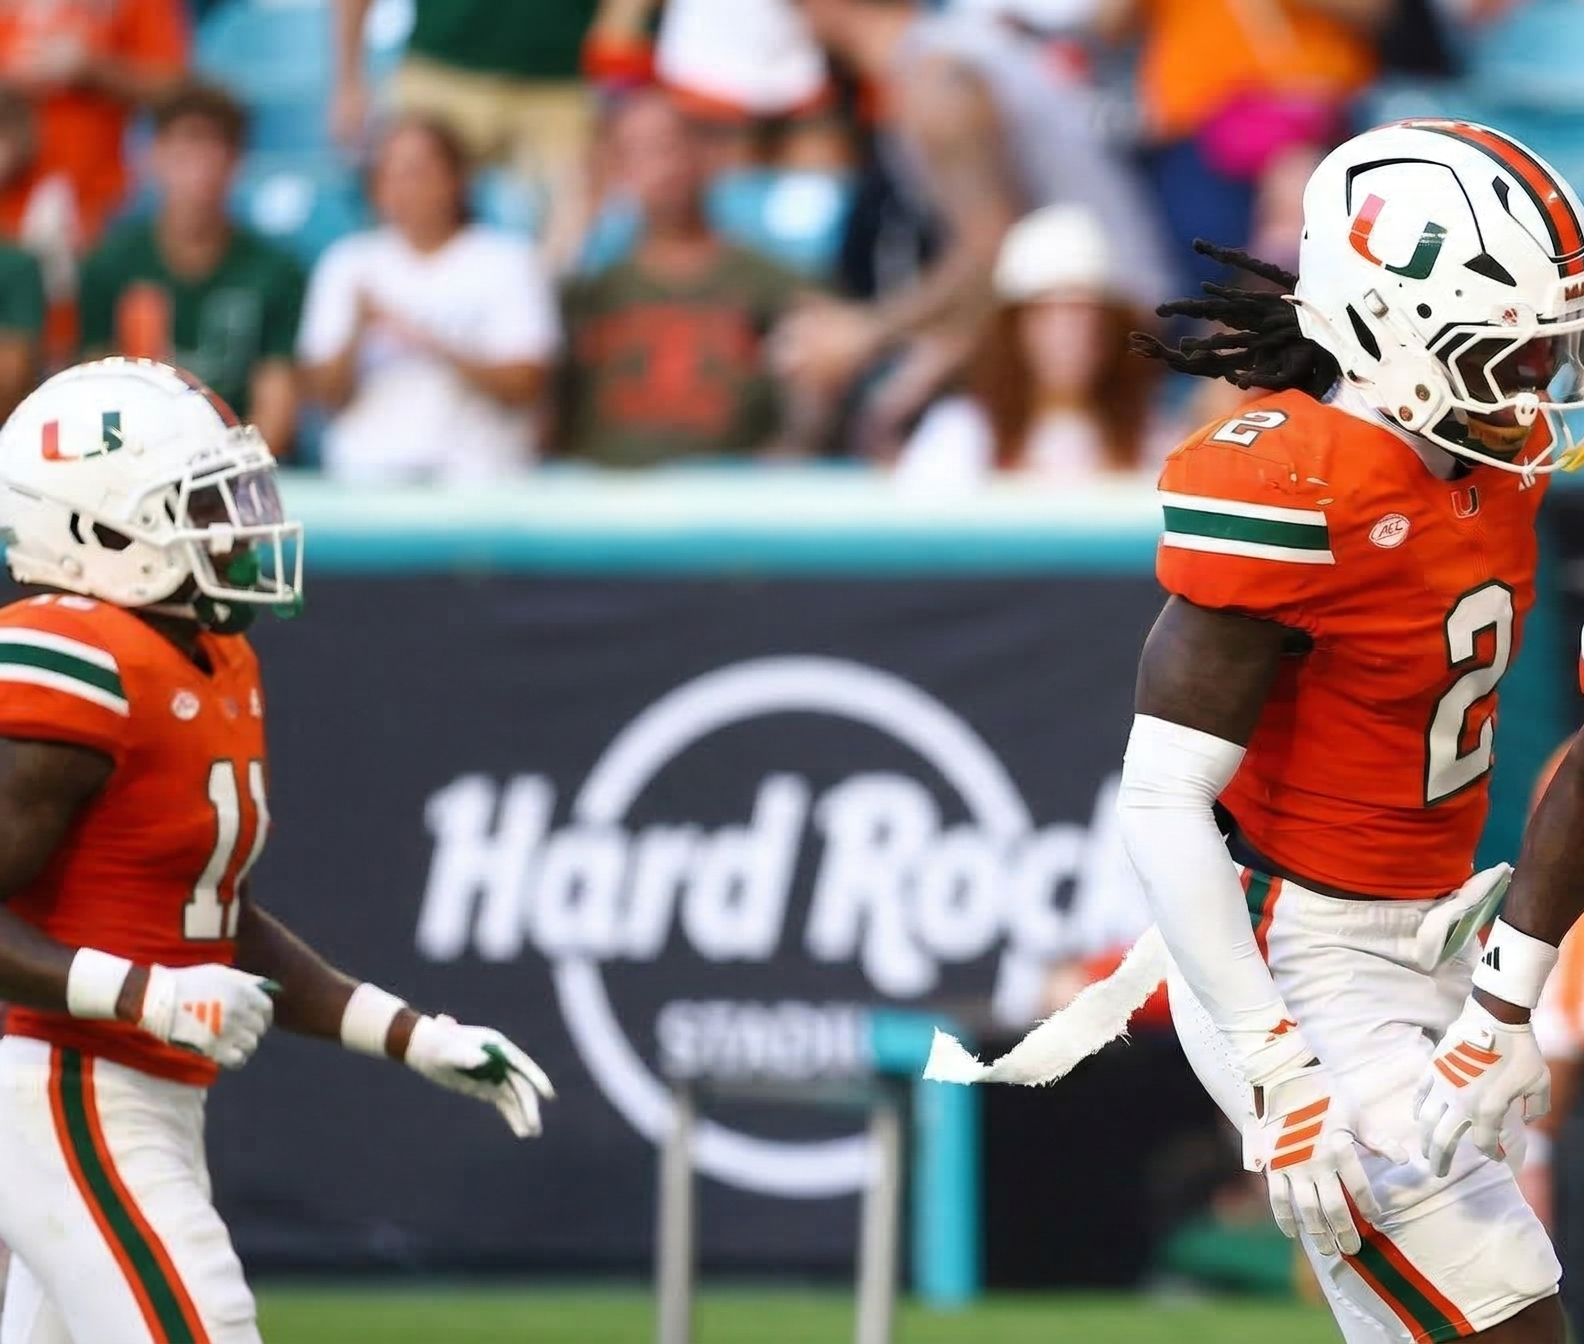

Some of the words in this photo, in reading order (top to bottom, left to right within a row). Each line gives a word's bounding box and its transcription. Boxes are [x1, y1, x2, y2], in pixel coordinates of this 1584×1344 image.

[1349, 193, 1447, 280] U
[42, 411, 123, 461] U
[1211, 409, 1289, 447] 2
[1451, 485, 1480, 519] U
[1424, 579, 1514, 808] 2
[414, 770, 808, 962] Hard
